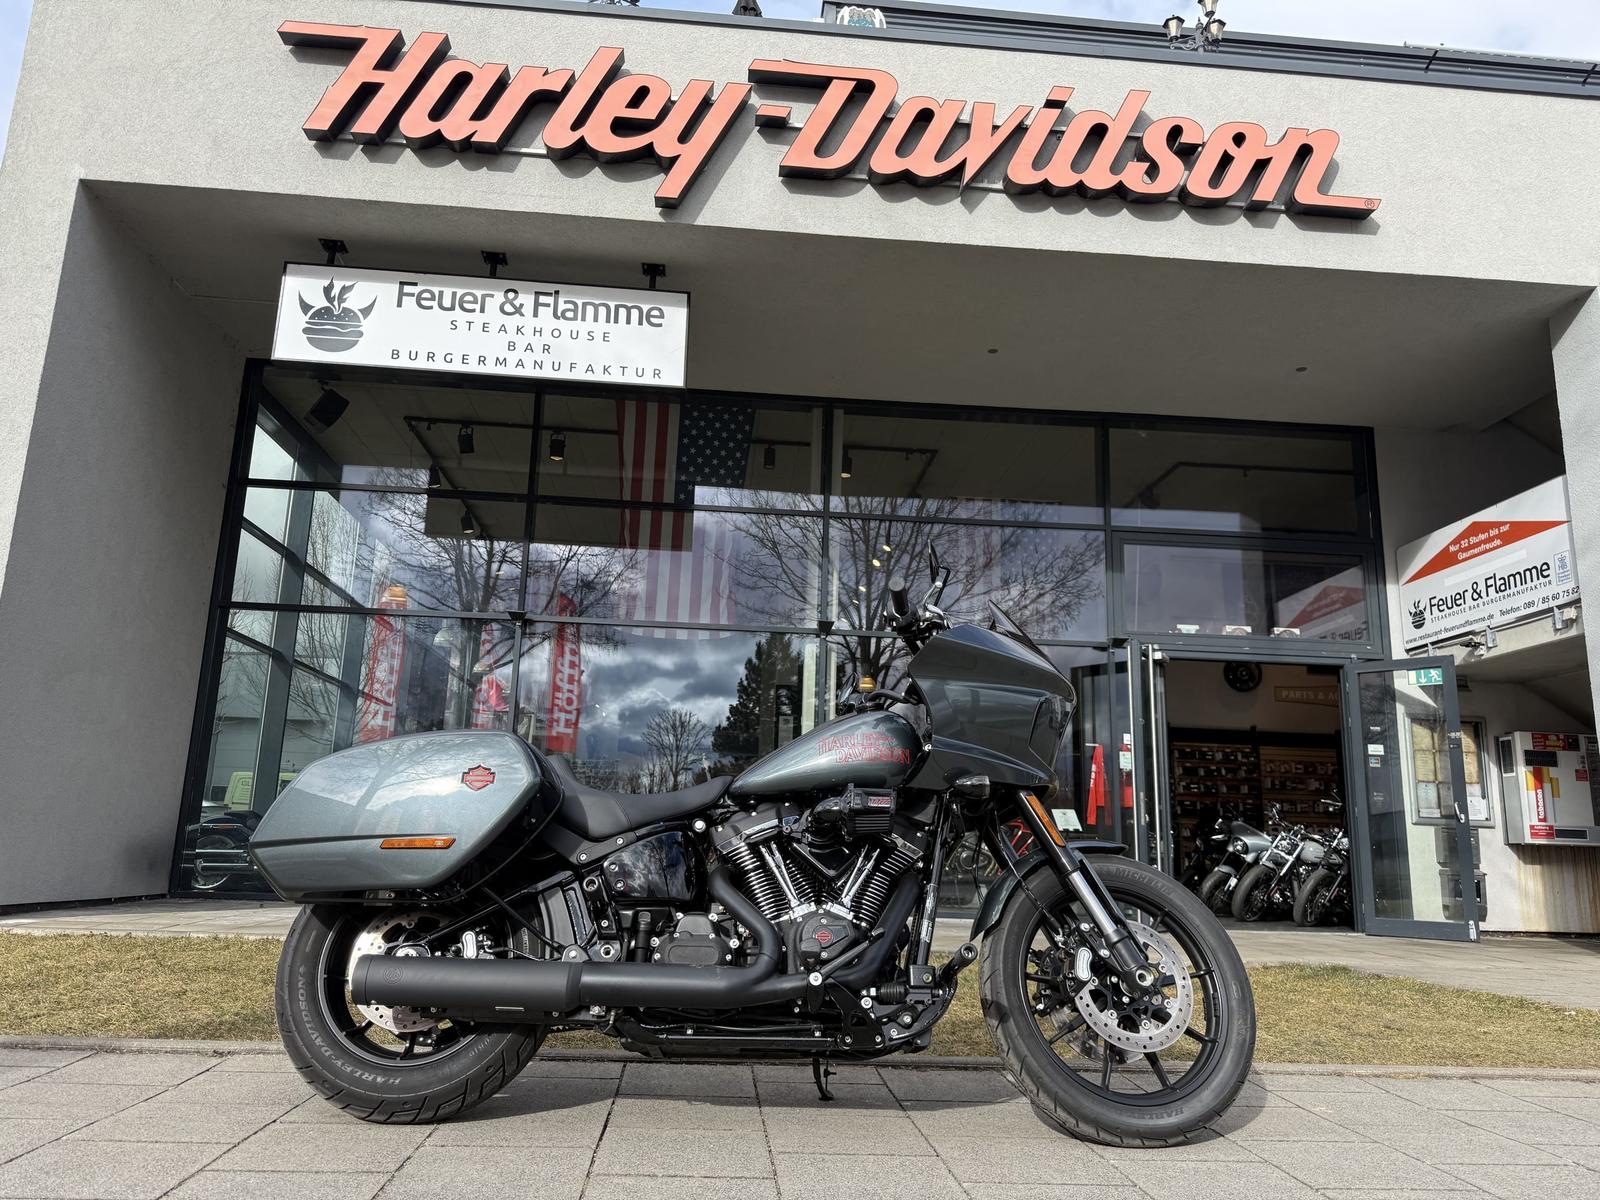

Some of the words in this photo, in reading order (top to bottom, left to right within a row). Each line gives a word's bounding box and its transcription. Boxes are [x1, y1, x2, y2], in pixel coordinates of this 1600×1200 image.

[277, 20, 1381, 212] Harley-Davidson
[396, 280, 495, 314] Feuer
[499, 288, 525, 317] &
[532, 289, 665, 328] Flamme
[449, 319, 611, 343] STEAKHOUSE
[507, 340, 552, 355] BAR
[390, 348, 662, 380] BURGERMANUFAKTUR
[1448, 543, 1460, 552] Nur
[1469, 532, 1488, 545] Stufen
[1489, 527, 1499, 537] bis
[1499, 523, 1510, 533] zur
[1428, 589, 1468, 616] Feuer
[1471, 581, 1483, 602] &
[1484, 562, 1551, 598] Flamme
[1430, 608, 1467, 623] STEAKHOUSE
[1468, 602, 1480, 612] BAR
[1482, 579, 1552, 607] BURGERMANUFAKTUR
[1522, 600, 1536, 610] 089
[1541, 595, 1550, 604] 85
[1551, 592, 1560, 601] 60
[1561, 589, 1571, 598] 75
[1570, 585, 1580, 595] 82
[1282, 689, 1315, 700] PARTS
